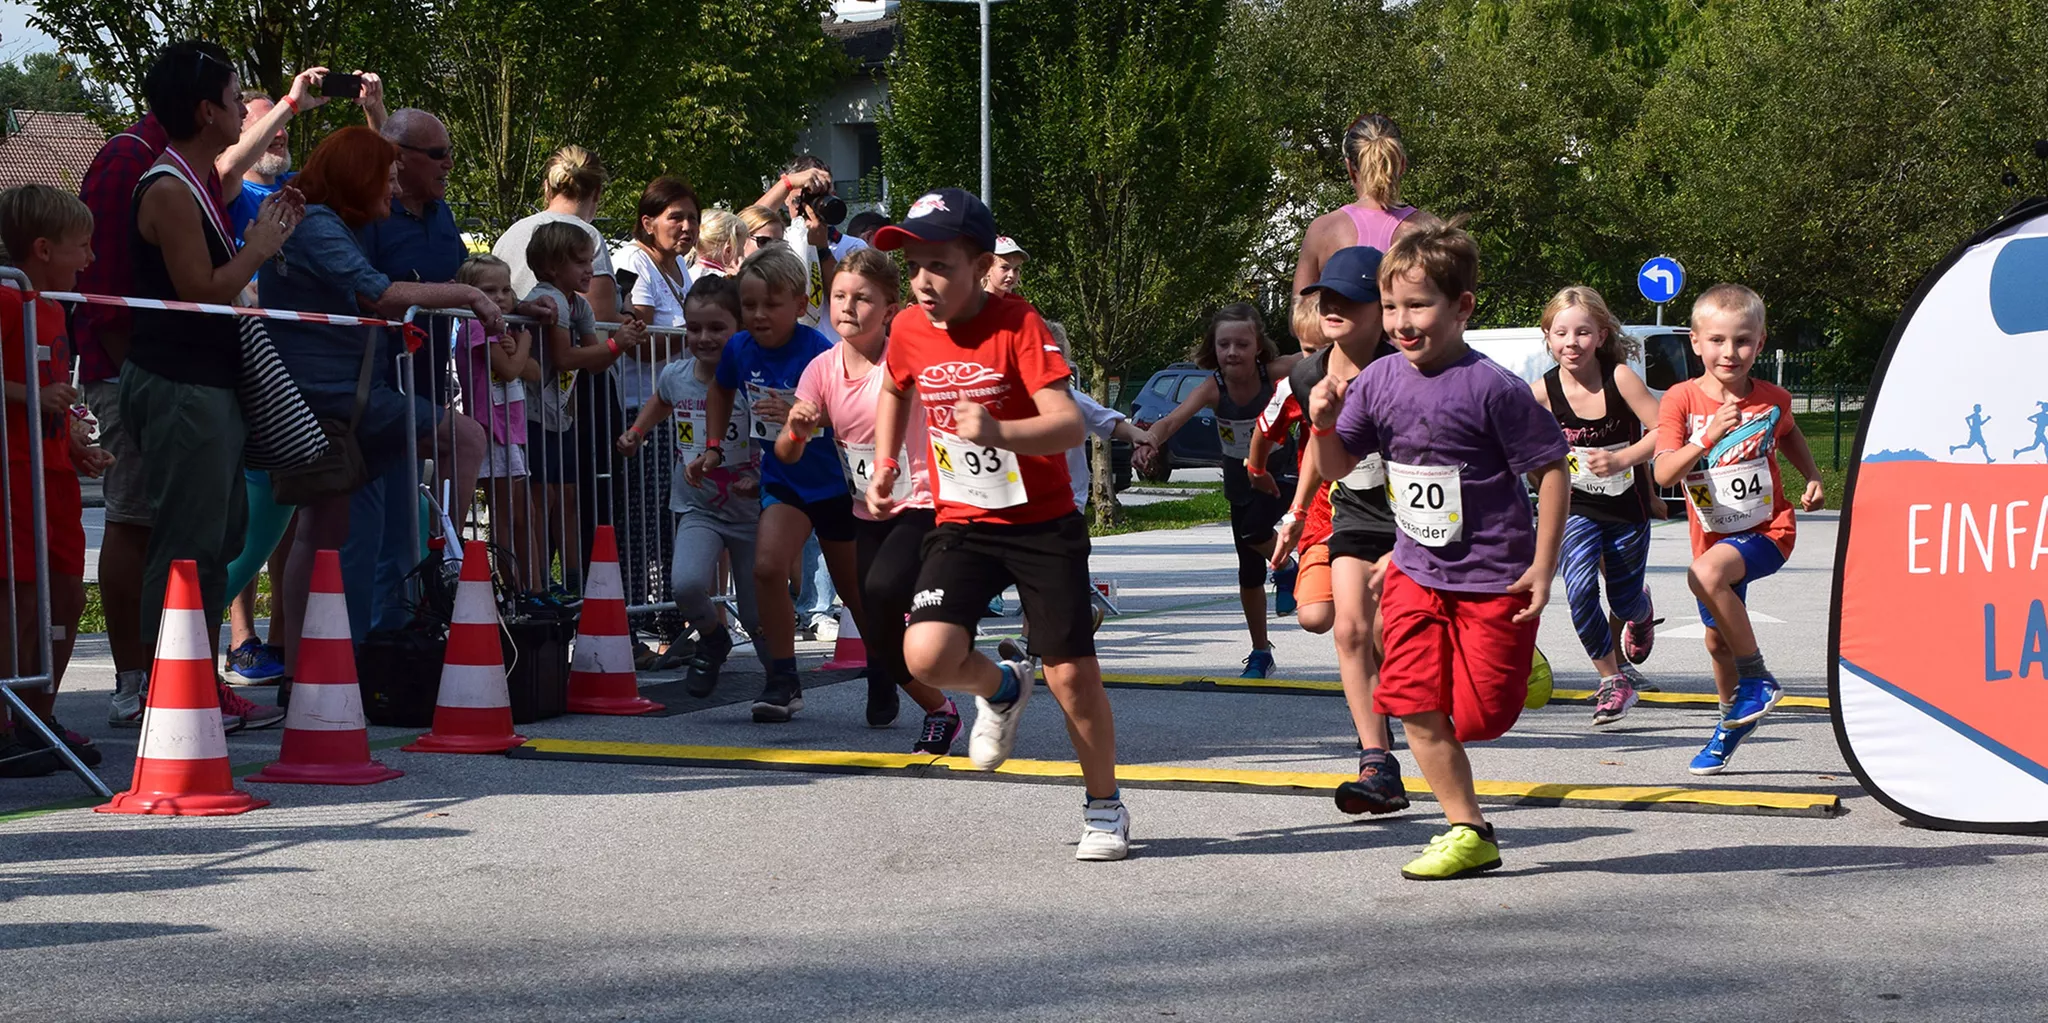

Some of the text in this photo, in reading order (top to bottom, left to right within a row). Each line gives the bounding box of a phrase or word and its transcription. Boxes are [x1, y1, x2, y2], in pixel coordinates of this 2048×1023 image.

[960, 383, 1012, 398] STERREICH
[726, 422, 739, 441] 3
[856, 458, 868, 481] 4
[964, 446, 1002, 476] 93
[1408, 482, 1445, 510] 20
[1731, 472, 1763, 501] 94
[1710, 509, 1753, 525] CHRISTIAN
[1984, 598, 2048, 682] LA
